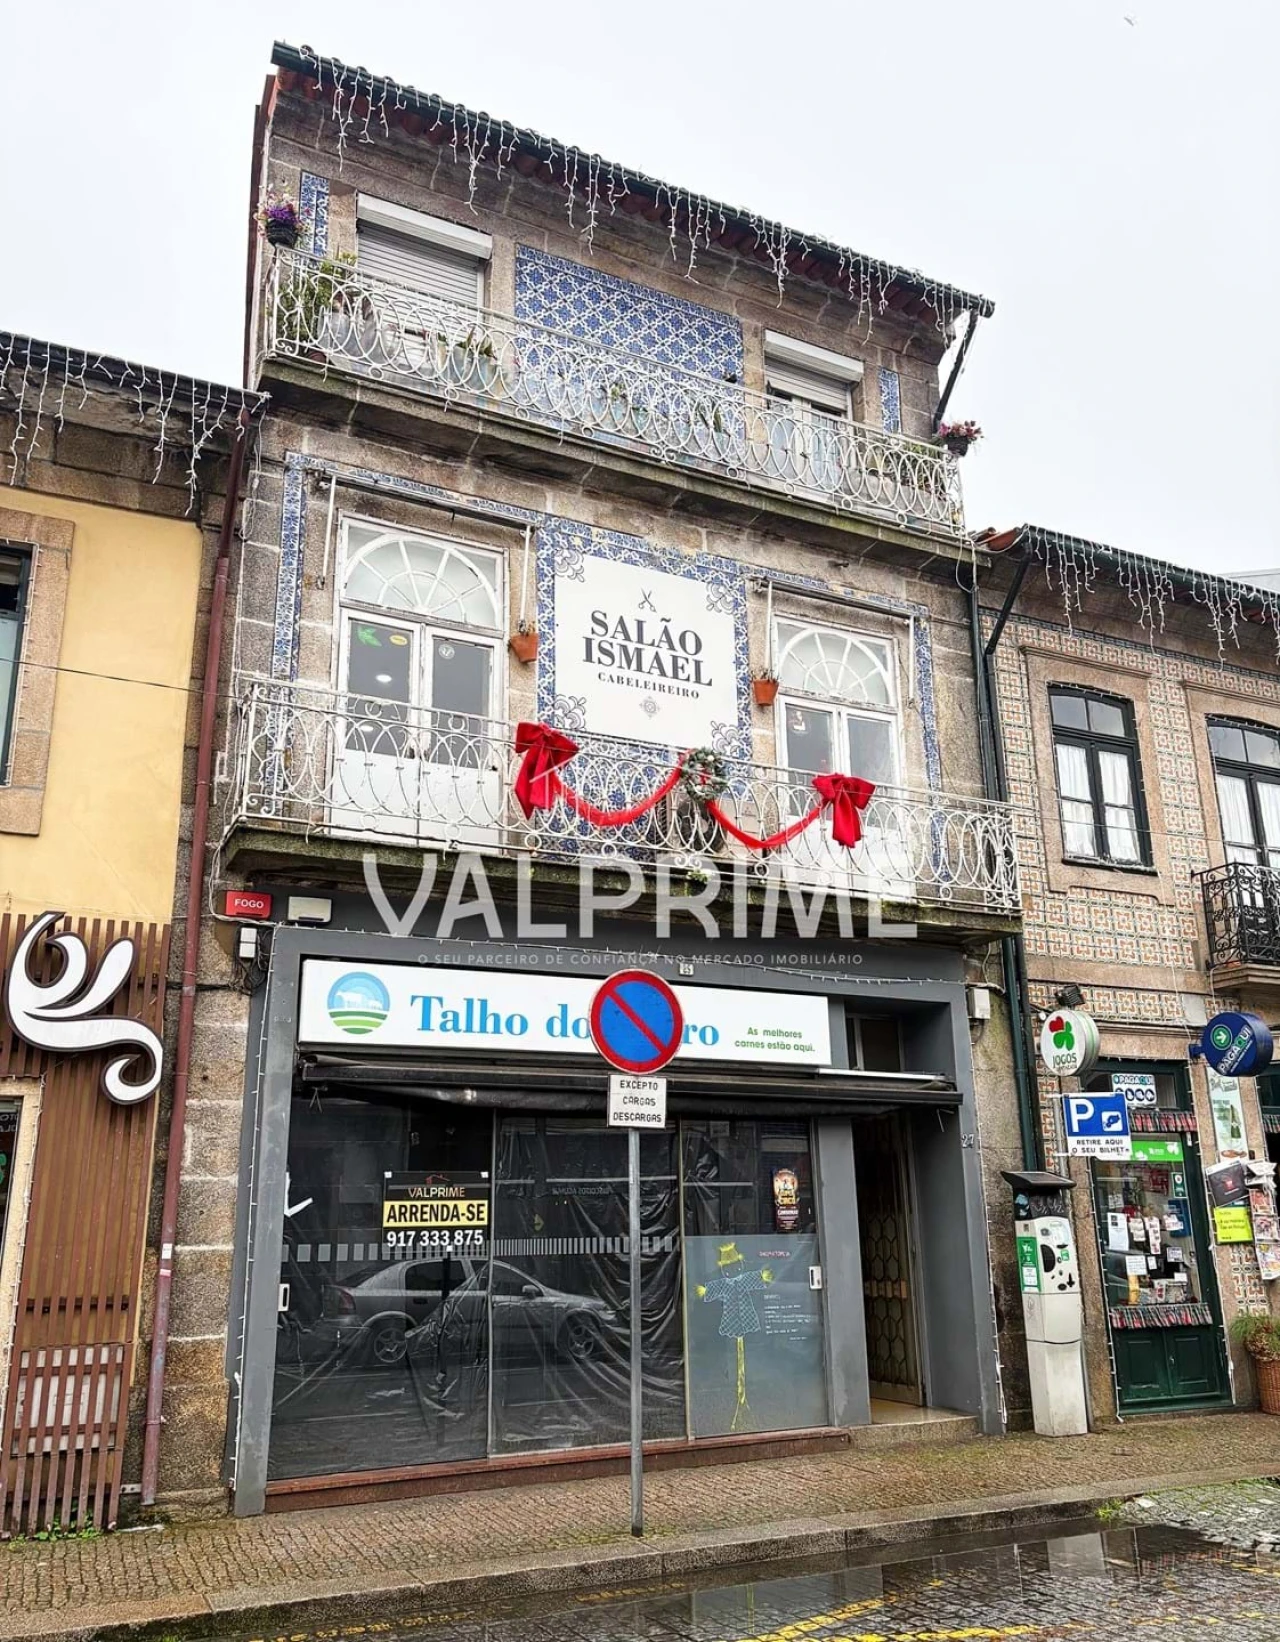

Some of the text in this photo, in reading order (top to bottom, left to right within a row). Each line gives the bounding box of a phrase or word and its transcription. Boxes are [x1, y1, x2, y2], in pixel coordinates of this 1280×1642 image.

[591, 610, 702, 656] SALÃO
[582, 636, 713, 687] ISMAEL
[598, 672, 700, 699] CABELEIREIRO
[234, 898, 264, 909] FOGO
[410, 994, 592, 1039] Talho do
[747, 1026, 802, 1039] As melhores
[734, 1040, 816, 1053] carnes estão aqui.
[1053, 1053, 1077, 1069] JOGOS
[619, 1079, 659, 1091] EXCEPTO
[622, 1096, 657, 1107] CARGAS
[613, 1112, 662, 1123] DESCARGAS
[1069, 1098, 1095, 1133] P
[407, 1187, 466, 1198] VALPRIME
[386, 1203, 486, 1223] ARRENDA-SE
[386, 1229, 484, 1247] 917 333 875
